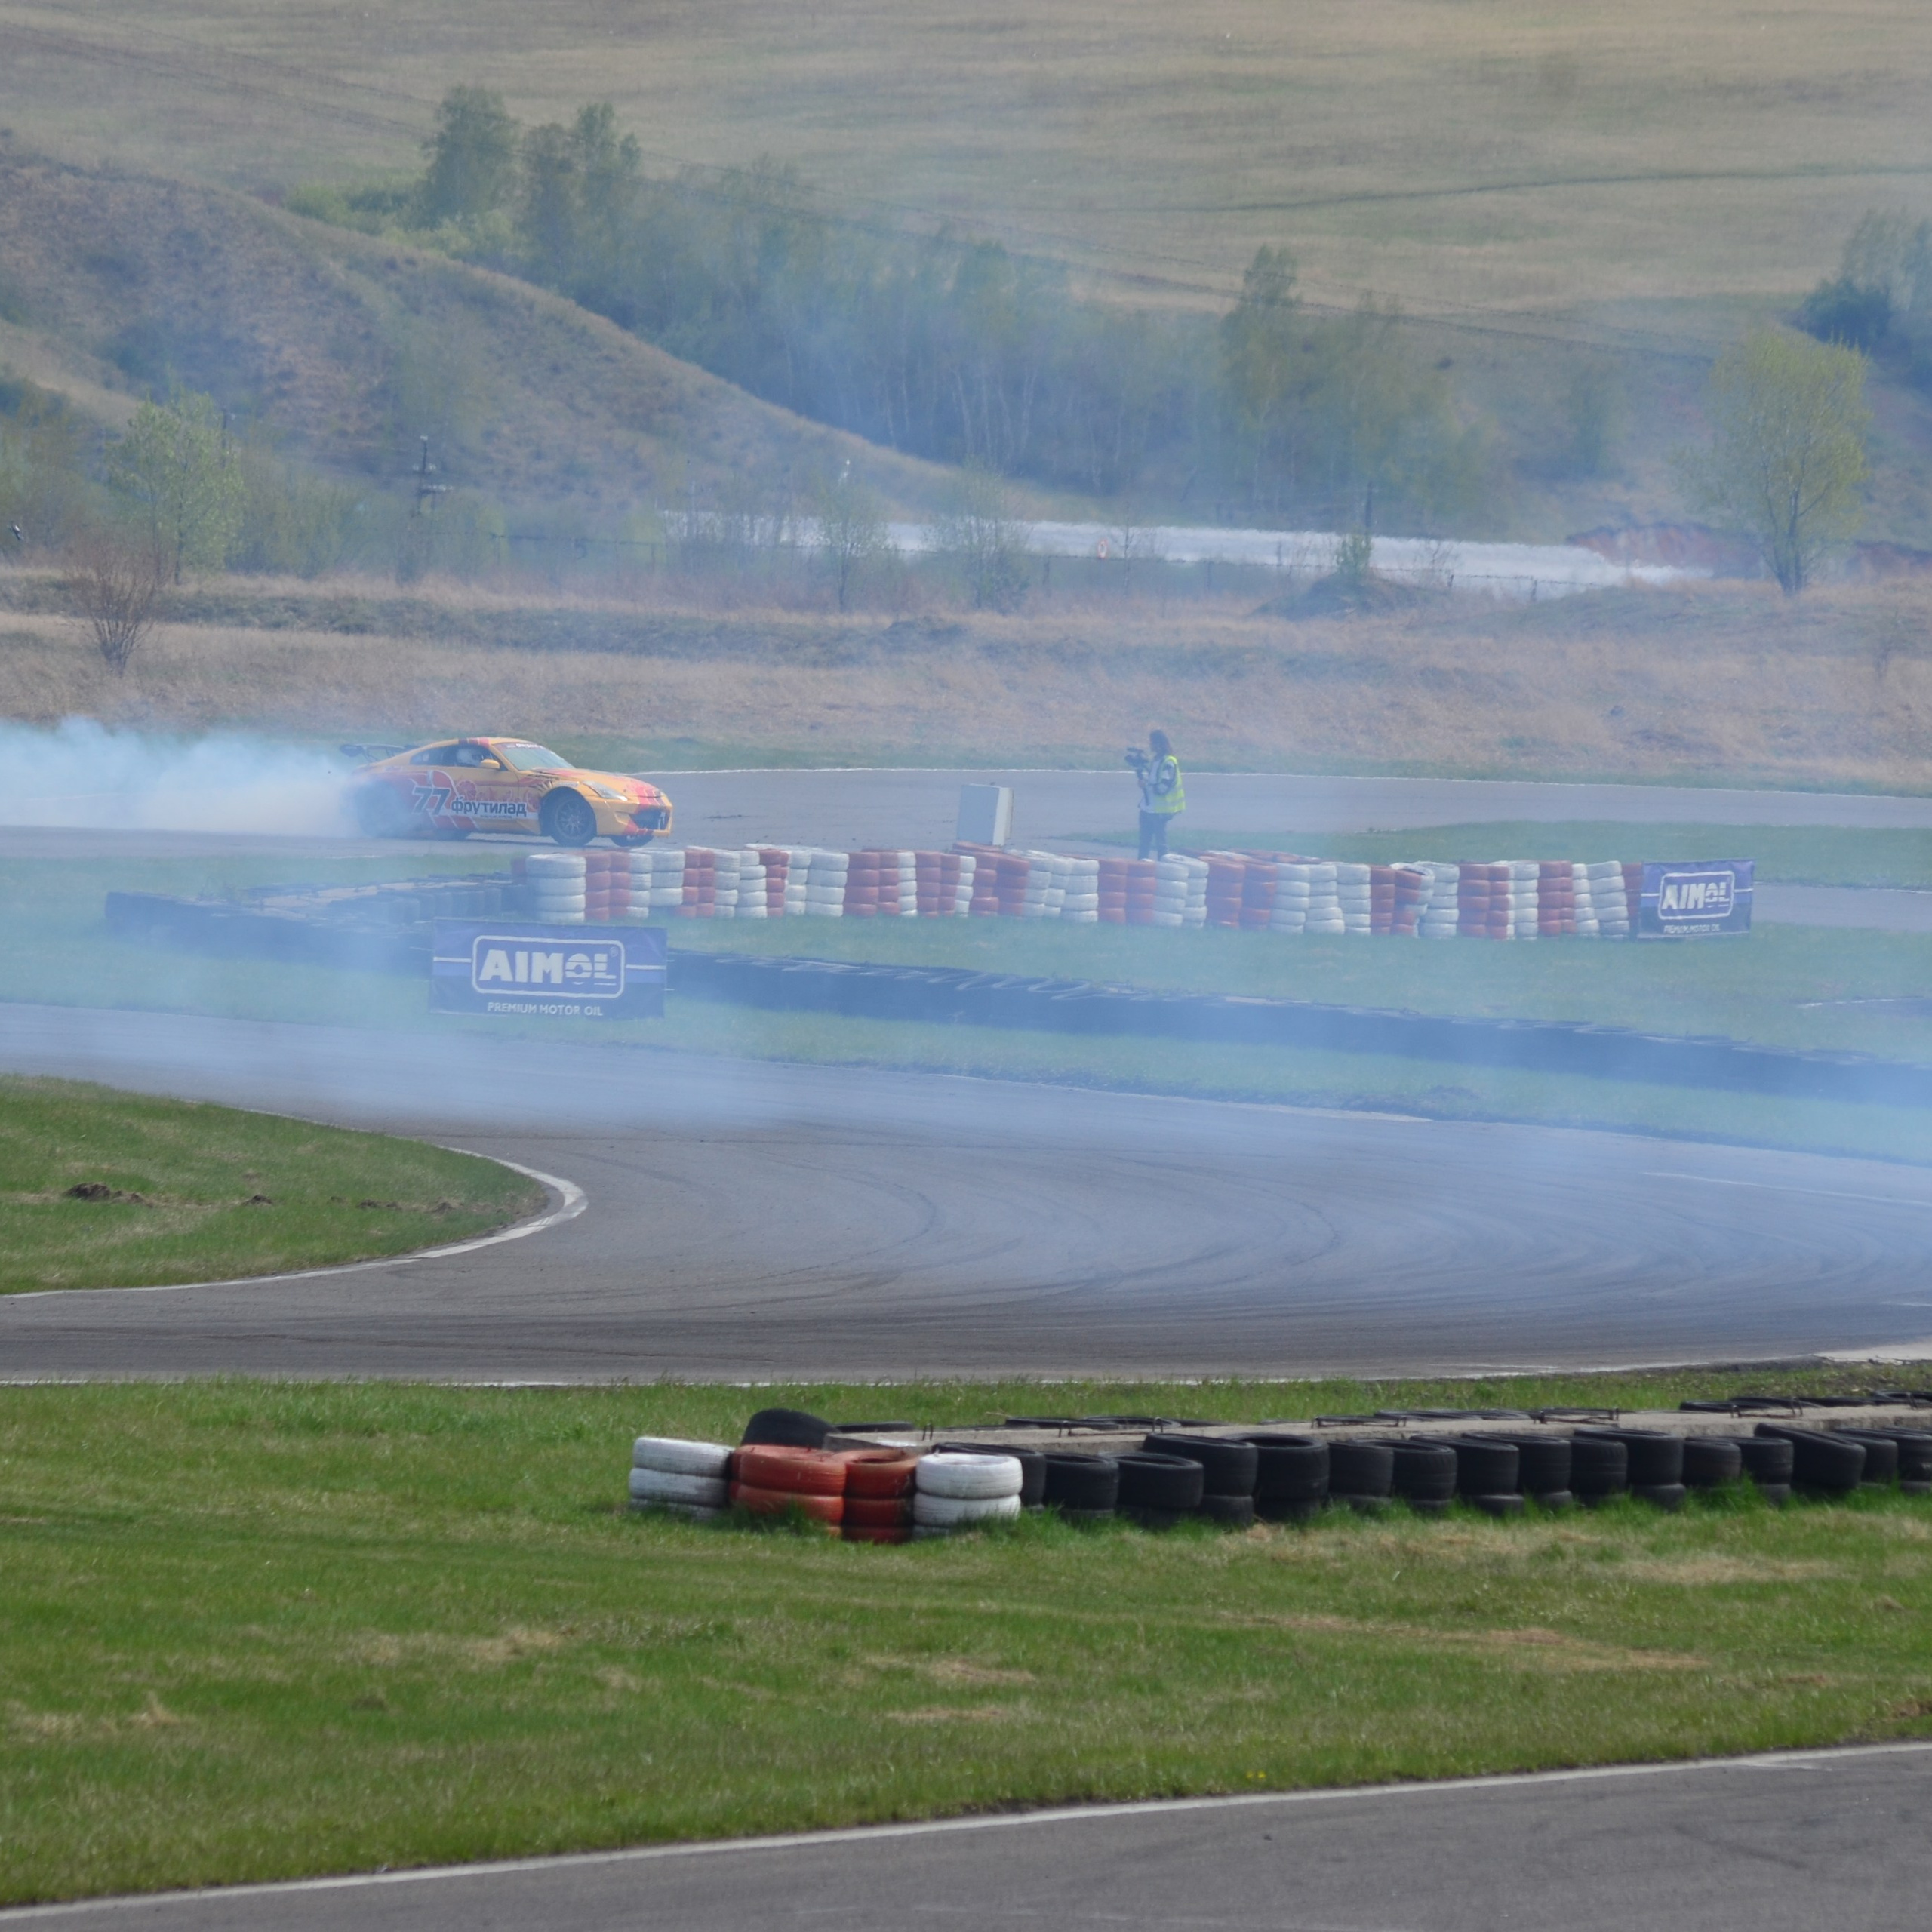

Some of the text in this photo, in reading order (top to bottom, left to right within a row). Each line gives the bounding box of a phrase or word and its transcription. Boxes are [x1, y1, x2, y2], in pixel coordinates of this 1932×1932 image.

[412, 786, 451, 816] 77
[1662, 881, 1730, 909] AIMOL
[478, 949, 617, 986] AIMOL
[487, 1001, 603, 1017] PREMIUM MOTOR OIL
